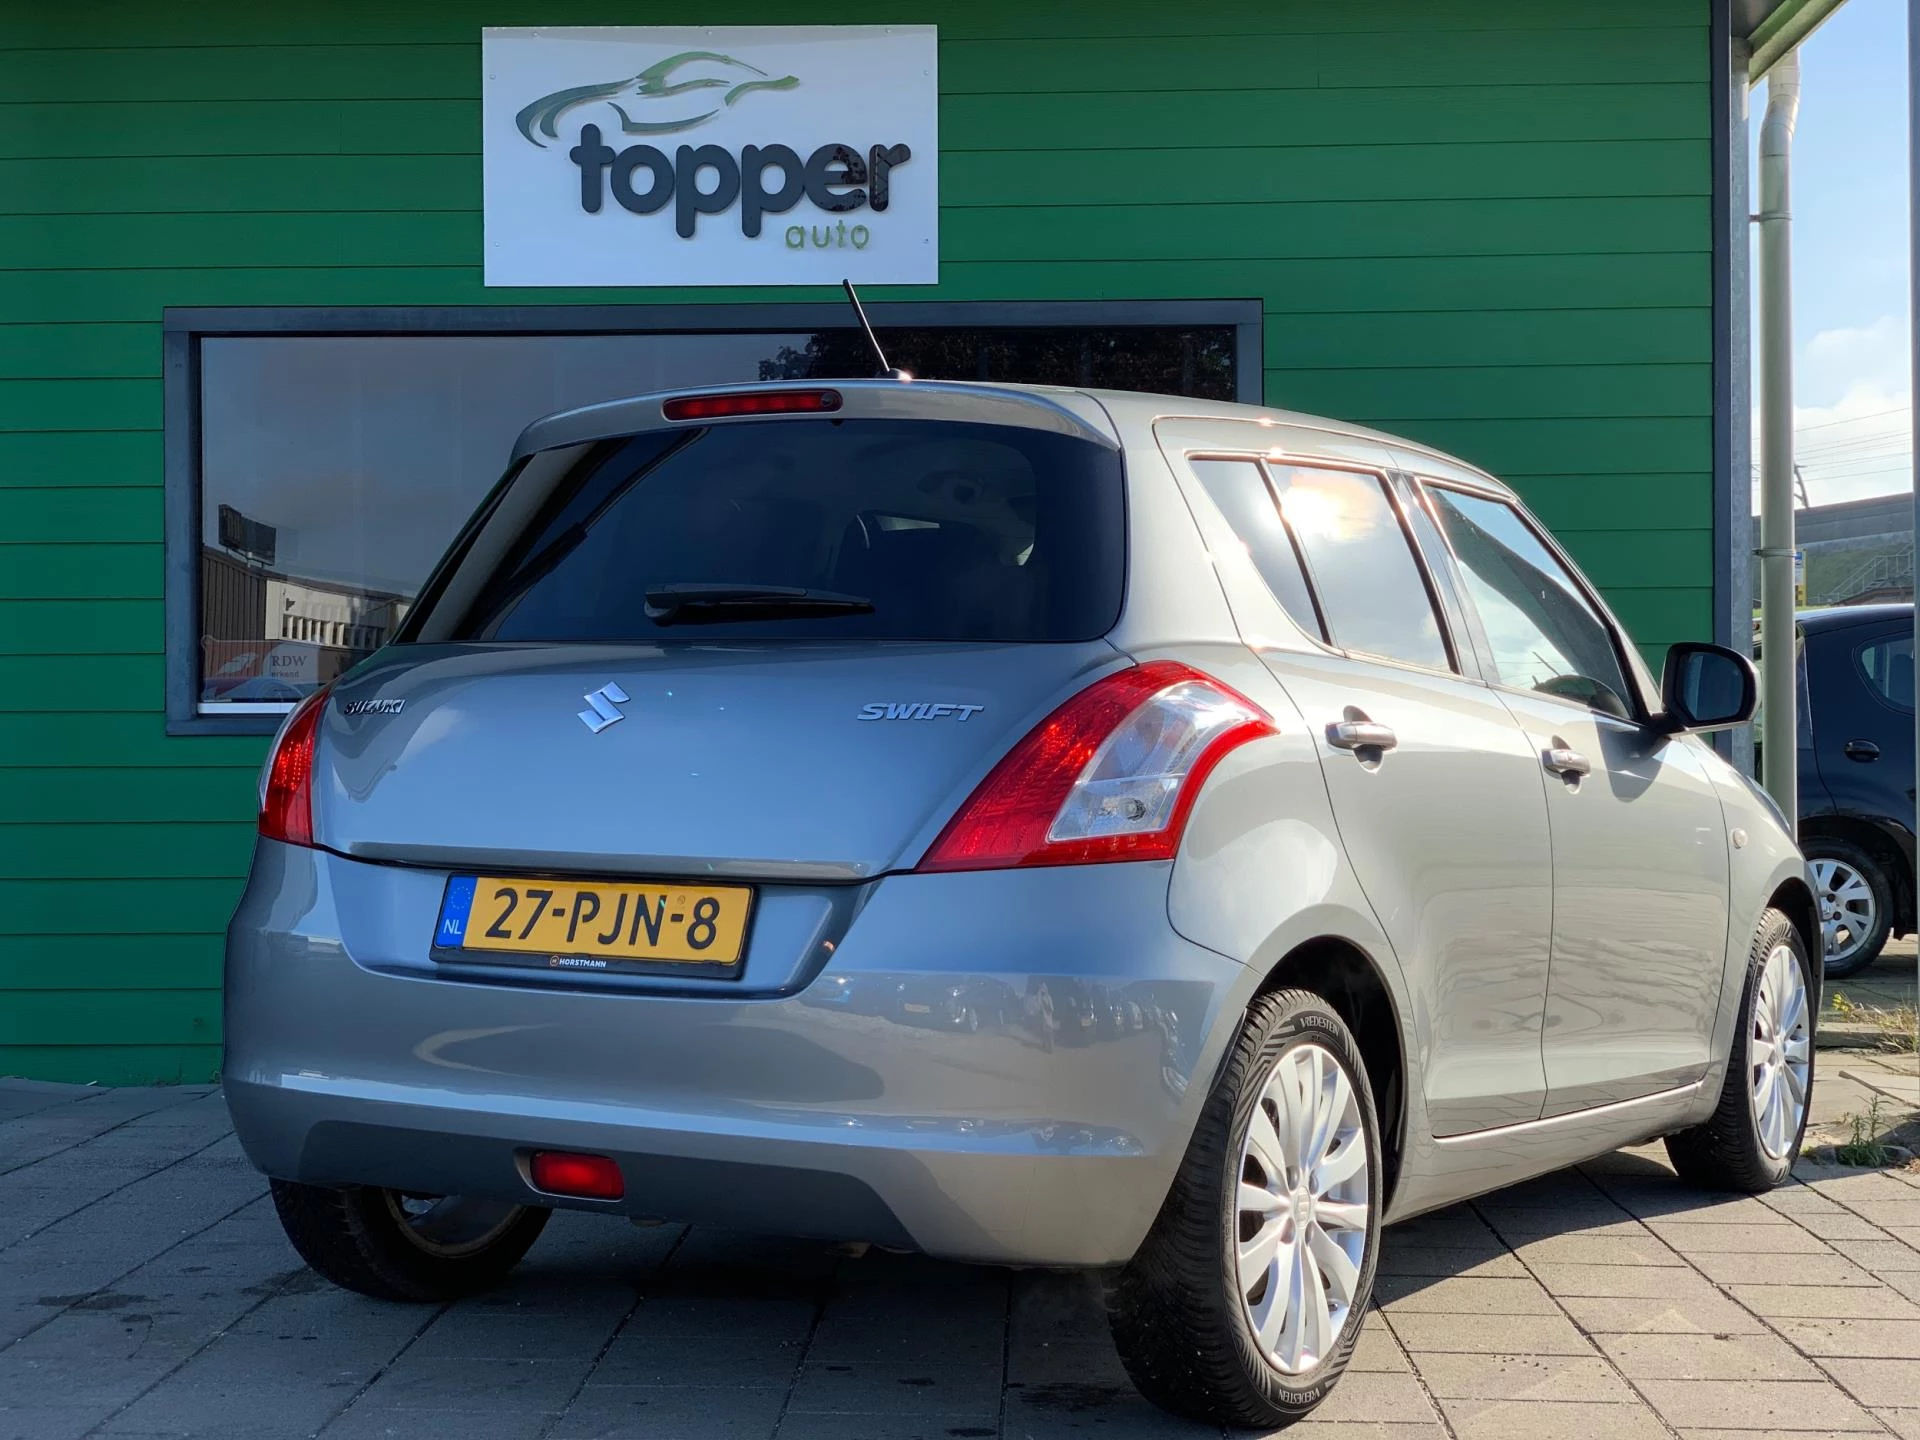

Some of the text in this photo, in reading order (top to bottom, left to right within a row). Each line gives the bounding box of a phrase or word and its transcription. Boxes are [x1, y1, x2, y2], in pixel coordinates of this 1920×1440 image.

[569, 123, 911, 239] topper
[785, 219, 870, 250] auto
[271, 655, 308, 667] RDW
[344, 699, 406, 714] SUZUKI
[857, 702, 985, 721] SWIFT
[443, 918, 462, 935] NL
[485, 886, 721, 950] 27-PJN-8
[559, 958, 607, 968] HORSTMANN
